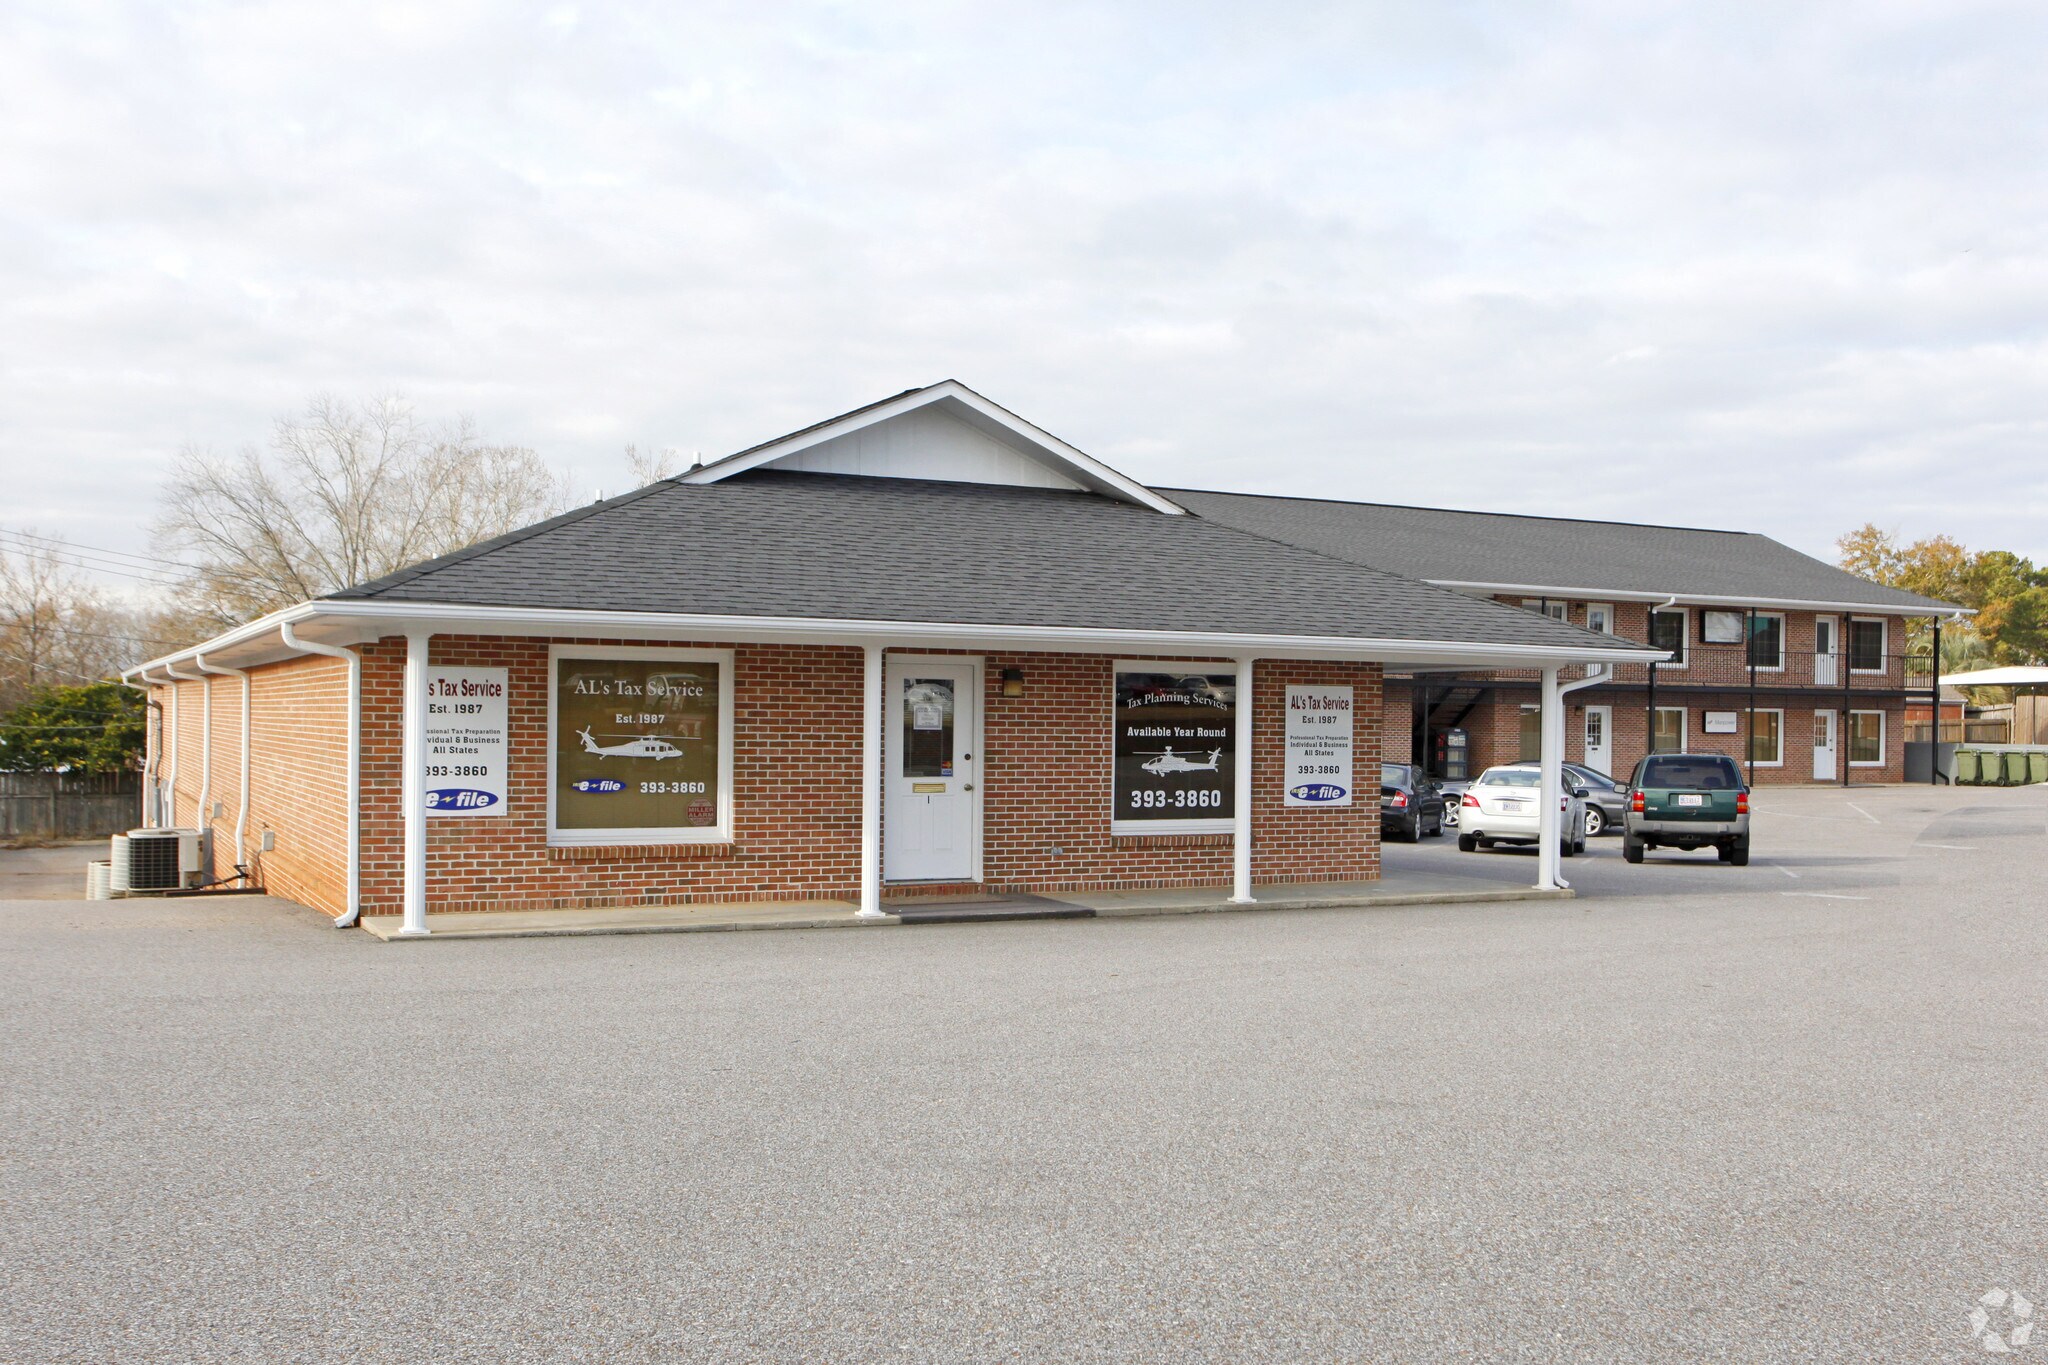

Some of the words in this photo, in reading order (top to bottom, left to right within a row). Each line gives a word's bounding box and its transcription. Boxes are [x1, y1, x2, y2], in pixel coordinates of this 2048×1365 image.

[438, 678, 458, 697] Tax
[461, 678, 502, 697] Service
[574, 679, 609, 695] AL's
[614, 680, 642, 696] Tax
[648, 681, 703, 697] Service
[1127, 698, 1142, 709] Tax
[1144, 691, 1190, 706] Planning
[1192, 692, 1228, 712] Services
[1291, 695, 1306, 710] AL's
[1308, 695, 1321, 710] Tax
[1323, 695, 1349, 710] Service
[429, 704, 451, 714] Est.
[454, 704, 483, 714] 1987
[615, 714, 636, 724] Est.
[639, 714, 665, 724] 1987
[1302, 715, 1316, 724] Est.
[1318, 715, 1337, 724] 1987
[1127, 727, 1171, 737] Available
[1173, 727, 1194, 737] Year
[1197, 727, 1226, 737] Round
[463, 736, 500, 744] Business
[433, 746, 446, 754] All
[449, 746, 479, 754] States
[1298, 765, 1340, 774] 393-3860
[640, 782, 705, 794] 393-3860
[1131, 789, 1221, 808] 393-3860
